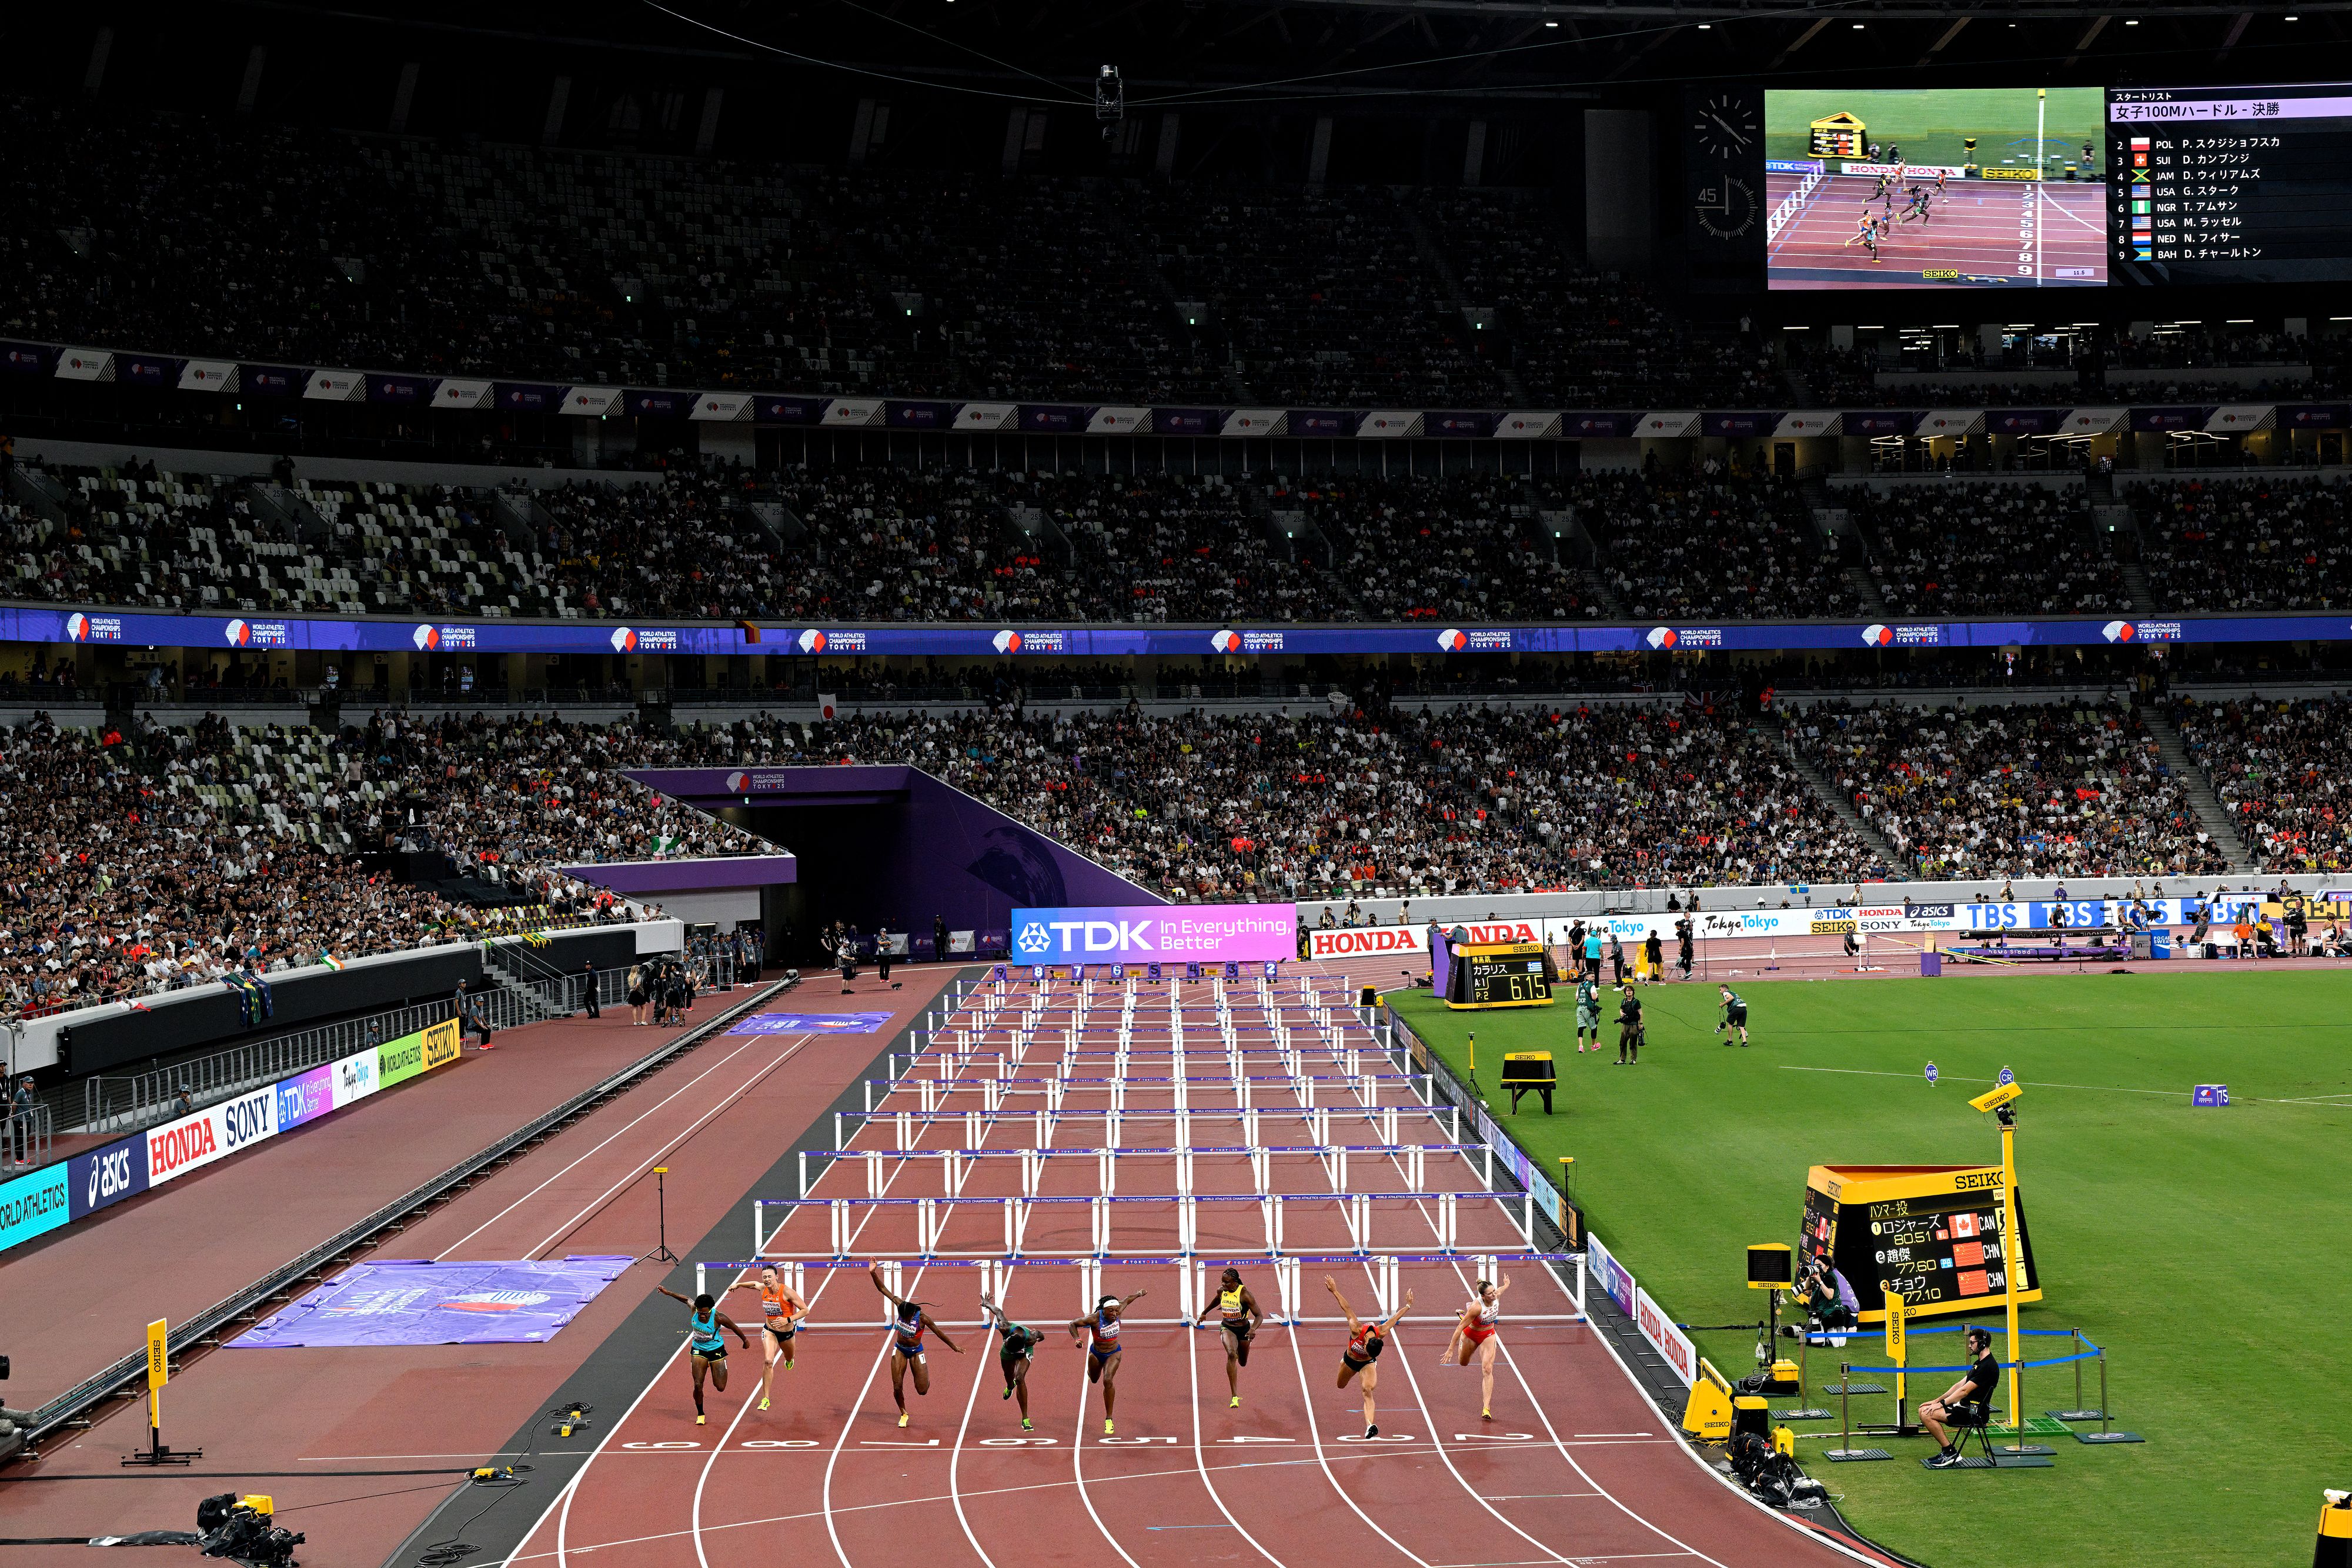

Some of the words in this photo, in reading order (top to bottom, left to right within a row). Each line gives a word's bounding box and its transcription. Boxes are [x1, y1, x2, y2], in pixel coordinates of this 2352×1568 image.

[2116, 92, 2171, 101] スタートリスト
[2116, 104, 2237, 119] 女子100Mハードル
[2252, 102, 2280, 116] 決勝
[2156, 141, 2173, 149] POL
[2183, 140, 2192, 148] P.
[2196, 137, 2280, 148] スクジショフスカ
[2117, 157, 2123, 165] 3
[2156, 156, 2170, 165] SUI
[2183, 156, 2193, 164] D.
[2197, 153, 2249, 164] カンブンジ
[1986, 169, 2035, 179] SEIKO
[2117, 173, 2123, 181] 4
[2156, 172, 2174, 180] JAM
[2183, 172, 2193, 180] D.
[2198, 168, 2260, 180] ウィリアムズ
[1698, 188, 1716, 202] 45
[2157, 188, 2176, 196] USA
[2184, 187, 2194, 195] G.
[2198, 185, 2239, 195] スターク
[2118, 205, 2124, 213] 6
[2157, 203, 2176, 212] NGR
[2197, 201, 2237, 211] アムサン
[2118, 220, 2124, 228] 7
[2157, 219, 2176, 227] USA
[2184, 218, 2196, 226] M.
[2200, 217, 2241, 227] ラッセル
[2119, 235, 2124, 243] 8
[2158, 235, 2176, 243] NED
[2184, 234, 2194, 242] N.
[2199, 232, 2240, 243] フィサー
[2158, 250, 2177, 259] BAH
[2185, 250, 2195, 258] D.
[2199, 248, 2261, 259] チャールトン
[1823, 909, 1852, 919] TDK
[1922, 906, 1948, 916] asics
[1967, 904, 2017, 928] TBS
[1161, 920, 1176, 934] In
[1182, 917, 1291, 936] Everything,
[1609, 920, 1643, 936] Tokyo
[1705, 915, 1742, 935] Tokyo
[1740, 915, 1778, 931] Tokyo
[1812, 921, 1856, 934] SEIKO
[1860, 921, 1901, 930] SONY
[1910, 920, 1930, 930] Tokyo
[1050, 921, 1155, 951] TDK
[1161, 936, 1222, 950] Better
[1315, 930, 1417, 954] HONDA
[997, 968, 1004, 977] 9
[1035, 967, 1043, 977] 8
[1074, 966, 1082, 976] 7
[1114, 965, 1121, 975] 6
[1151, 965, 1158, 974] 5
[1189, 964, 1197, 974] 4
[1228, 964, 1235, 973] 3
[1267, 964, 1275, 974] 2
[1474, 965, 1508, 975] カラリス
[1510, 975, 1545, 999] 6.15
[427, 1022, 455, 1066] SEIKO
[386, 1054, 400, 1074] WORLD
[400, 1045, 421, 1068] ATHLETICS
[343, 1064, 356, 1099] Tokyo
[355, 1061, 368, 1086] Tokyo
[306, 1081, 310, 1096] In
[2218, 1089, 2229, 1103] 75
[285, 1083, 307, 1121] TDK
[307, 1097, 319, 1112] Better
[1984, 1092, 2009, 1109] SEIKO
[226, 1094, 269, 1147] SONY
[151, 1117, 216, 1176] HONDA
[101, 1148, 129, 1197] asics
[1828, 1181, 1842, 1199] SEIKO
[0, 1199, 21, 1230] ORLD
[23, 1183, 65, 1222] ATHLETICS
[1870, 1201, 1909, 1218] ハンマー投
[1883, 1213, 1940, 1233] ロジャーズ
[1978, 1215, 1996, 1231] CAN
[1894, 1231, 1931, 1245] 80.51
[1591, 1244, 1599, 1275] TDK
[1887, 1247, 1911, 1263] 趙傑
[1983, 1243, 2000, 1259] CHN
[1896, 1259, 1936, 1275] 77.60
[1943, 1259, 1952, 1268] PB
[1611, 1266, 1620, 1297] TDK
[1892, 1275, 1926, 1292] チョウ
[1987, 1272, 2004, 1288] CHN
[1903, 1288, 1940, 1303] 77.10
[1640, 1300, 1662, 1348] HONDA
[1664, 1327, 1689, 1379] HONDA
[153, 1340, 161, 1373] SEIKO
